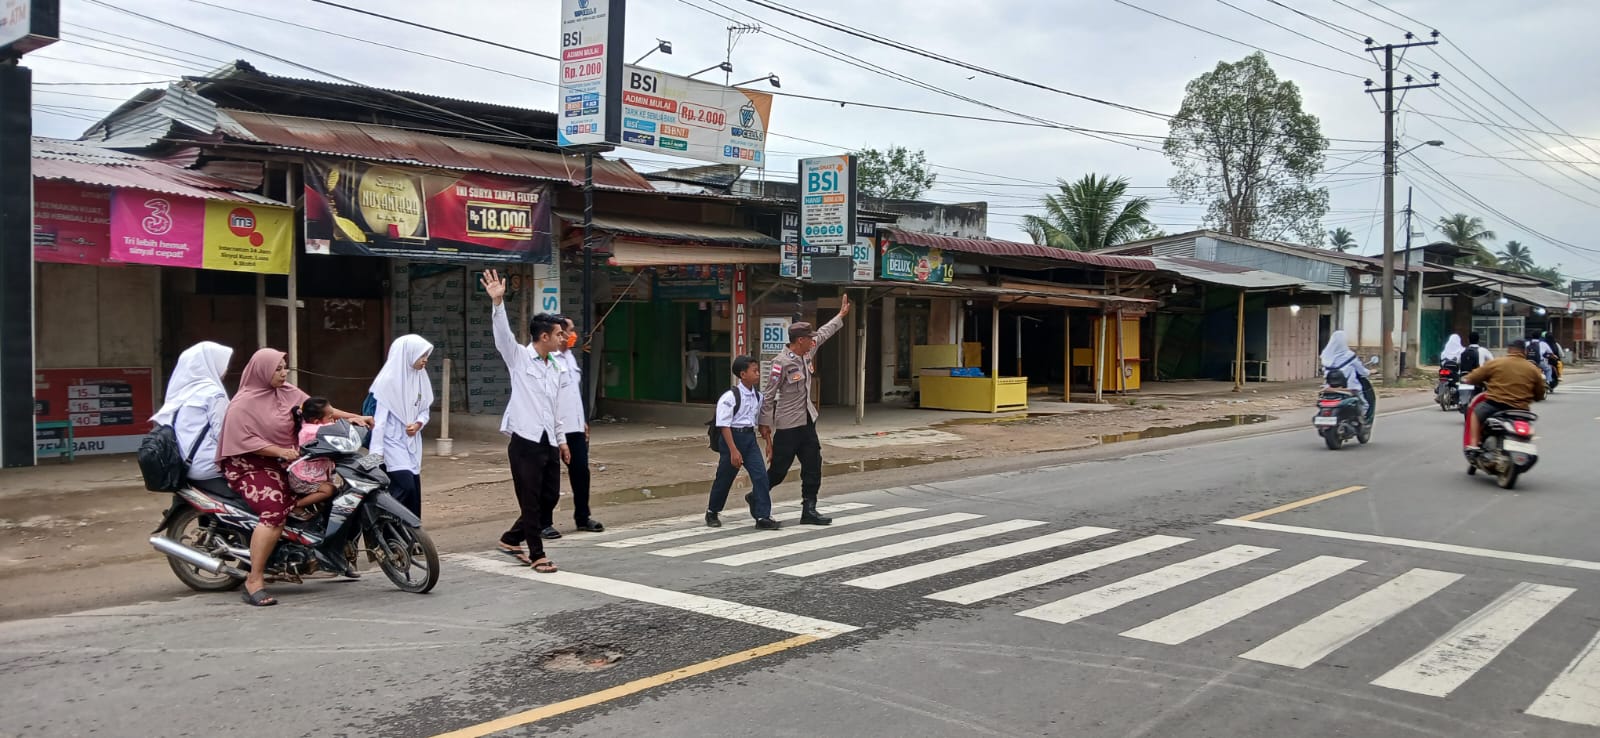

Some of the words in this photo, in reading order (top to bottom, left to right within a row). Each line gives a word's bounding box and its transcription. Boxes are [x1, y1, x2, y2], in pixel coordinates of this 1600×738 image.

[563, 30, 582, 47] BSI
[564, 66, 578, 79] Rp.
[579, 62, 601, 77] 2.000
[630, 72, 658, 93] BSI
[625, 94, 649, 106] ADMIN
[649, 98, 671, 110] MULAI
[681, 105, 696, 121] Rp.
[698, 109, 725, 126] 2.000
[671, 126, 686, 138] BNI
[808, 170, 839, 192] BSI
[456, 185, 467, 197] INI
[469, 187, 493, 199] SURYA
[494, 189, 516, 202] TANPA
[517, 192, 539, 203] FILTER
[123, 236, 135, 245] Tri
[136, 237, 158, 247] lebih
[129, 246, 154, 257] sinyal
[852, 245, 869, 261] BSI
[889, 259, 912, 273] DELUX
[943, 263, 954, 278] 16
[763, 327, 784, 342] BSI
[762, 343, 784, 351] HANI
